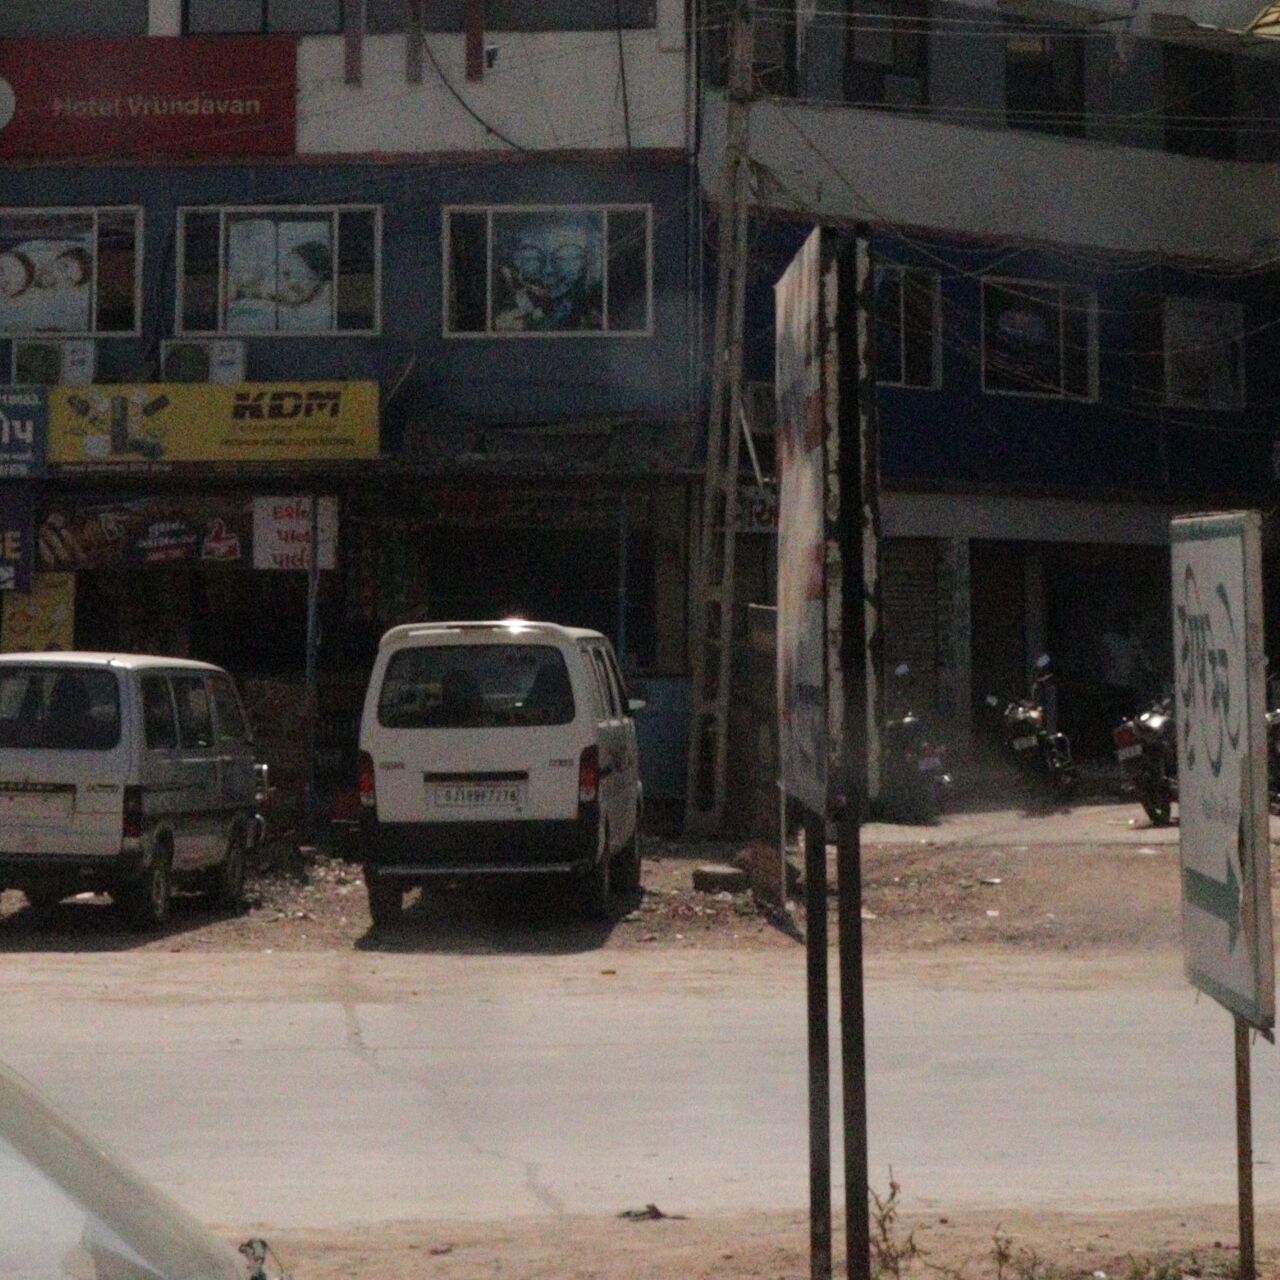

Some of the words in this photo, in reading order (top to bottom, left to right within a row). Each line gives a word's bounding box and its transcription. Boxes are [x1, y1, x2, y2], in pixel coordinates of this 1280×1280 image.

[52, 95, 120, 117] Hotel
[126, 94, 261, 117] Vrundavan
[232, 391, 342, 420] KDM
